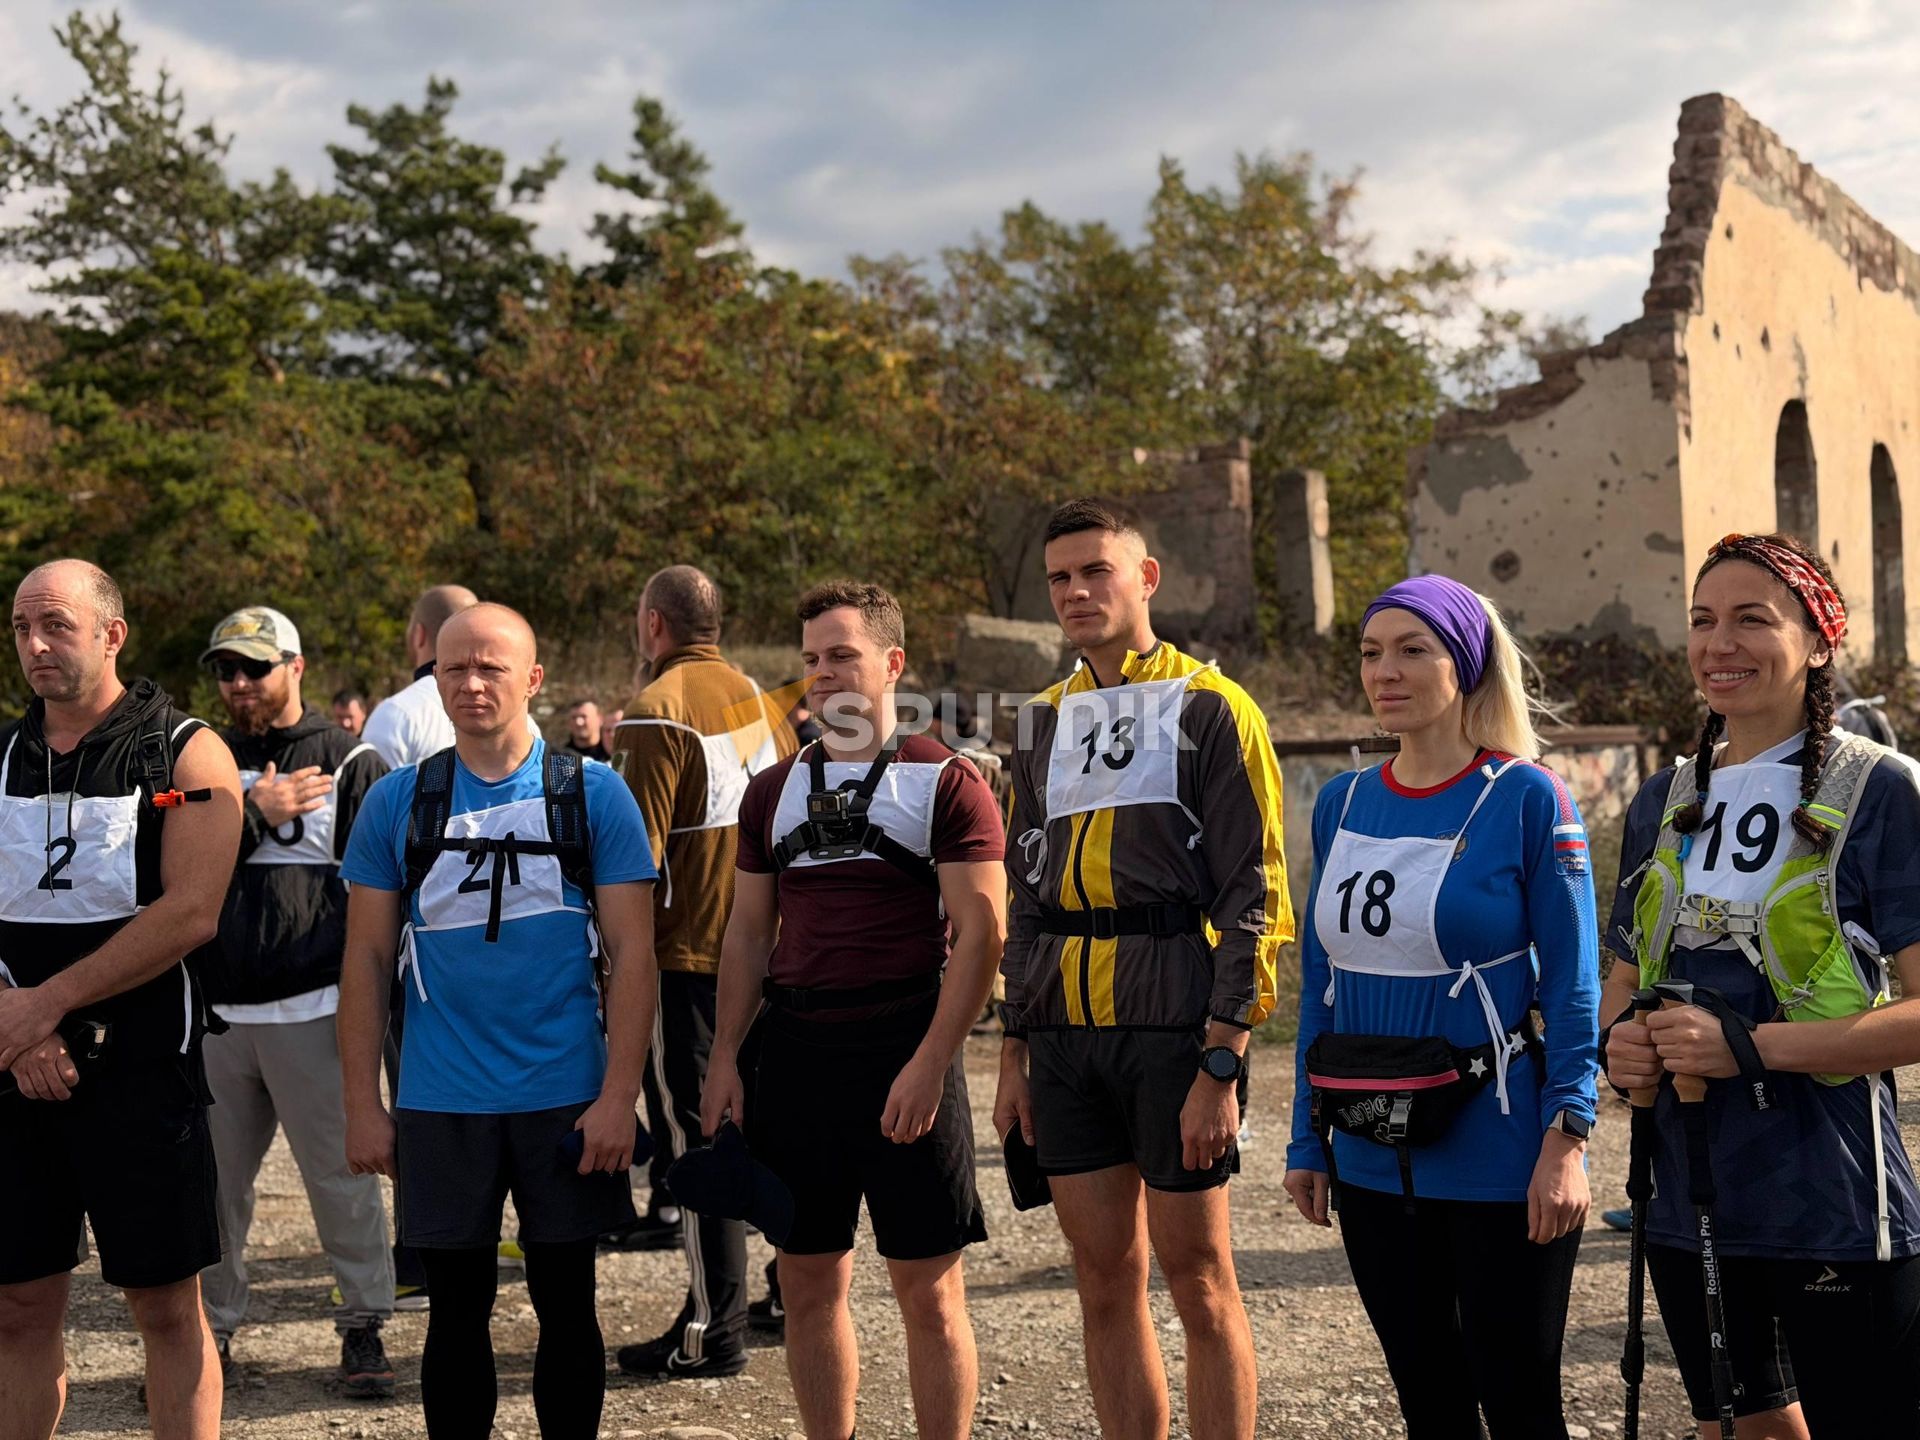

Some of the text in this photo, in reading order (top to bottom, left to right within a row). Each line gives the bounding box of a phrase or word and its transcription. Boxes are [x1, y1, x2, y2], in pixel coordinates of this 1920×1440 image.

[1080, 716, 1136, 774] 13
[38, 836, 77, 889] 2
[458, 831, 521, 894] 21
[1701, 802, 1780, 873] 19
[1336, 869, 1395, 937] 18
[1700, 1215, 1718, 1295] RoadLike Pro
[1804, 1284, 1852, 1292] DEMIX
